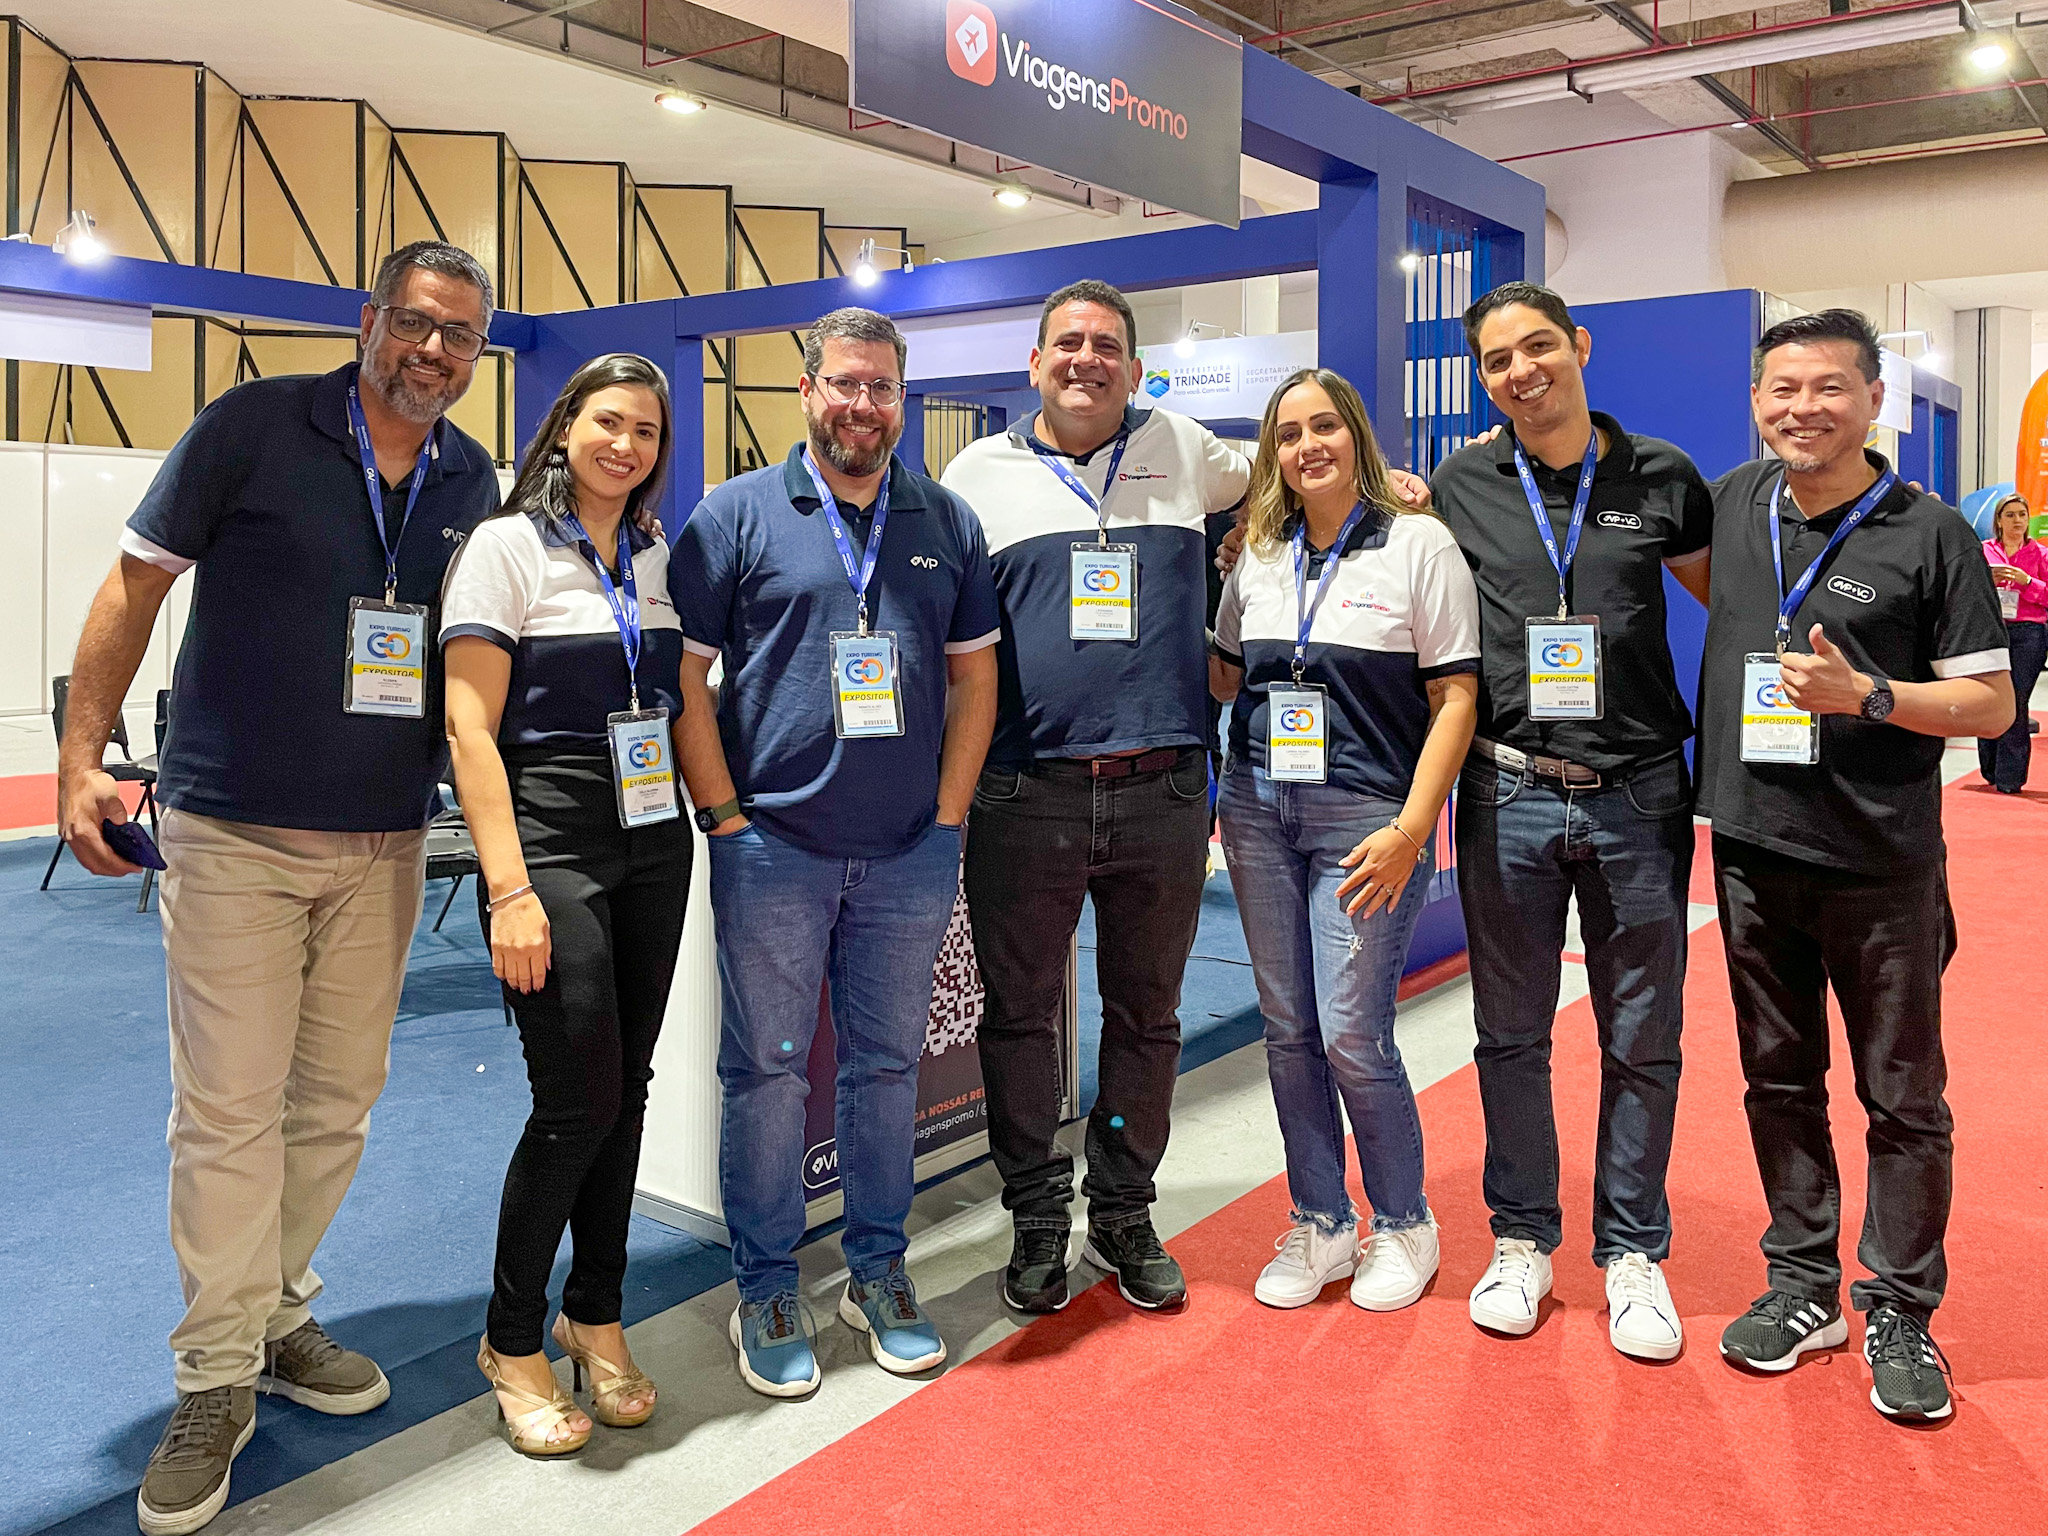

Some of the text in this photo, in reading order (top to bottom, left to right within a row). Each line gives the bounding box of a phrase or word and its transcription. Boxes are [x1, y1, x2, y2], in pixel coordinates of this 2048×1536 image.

[1001, 32, 1188, 140] ViagensPromo
[1174, 364, 1231, 375] PREFEITURA
[1246, 366, 1290, 376] SECRETARIA
[1175, 372, 1231, 387] TRINDADE
[1246, 375, 1278, 385] ESPORTE
[362, 667, 415, 678] EXPOSITOR
[1538, 676, 1588, 684] EXPOSITOR
[844, 692, 890, 702] EXPOSITOR
[1752, 717, 1803, 725] EXPOSITOR
[629, 774, 668, 788] EXPOSITOR
[928, 1093, 968, 1118] NOSSAS
